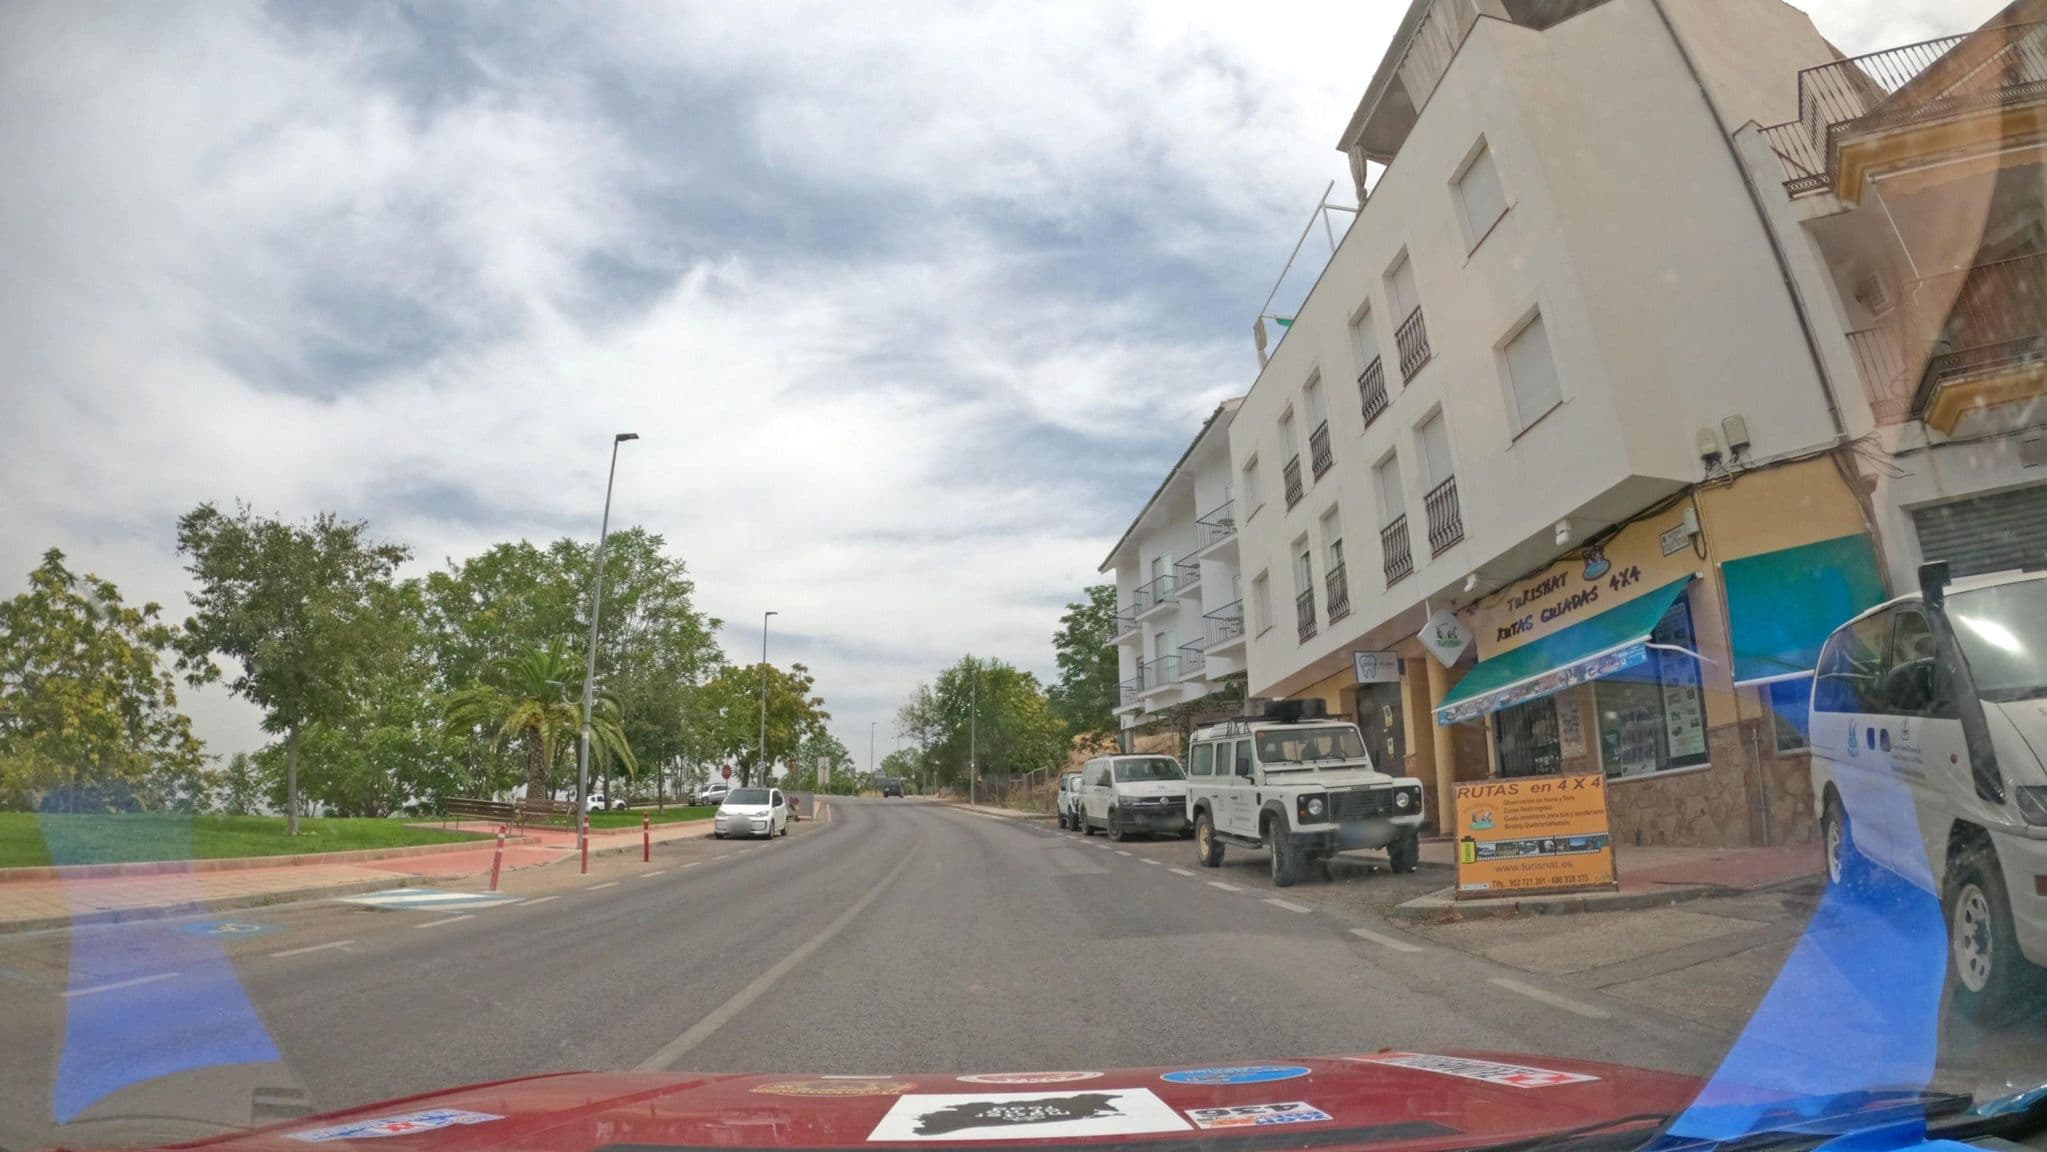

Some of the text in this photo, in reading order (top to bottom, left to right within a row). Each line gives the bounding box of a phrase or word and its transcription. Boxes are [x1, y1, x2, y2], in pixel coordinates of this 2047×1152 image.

[1496, 614, 1533, 642] RUTAS
[1540, 585, 1599, 622] GUIADAS
[1457, 784, 1519, 799] RUTAS
[1530, 783, 1551, 793] en
[1557, 780, 1567, 791] 4
[1591, 776, 1600, 787] 4
